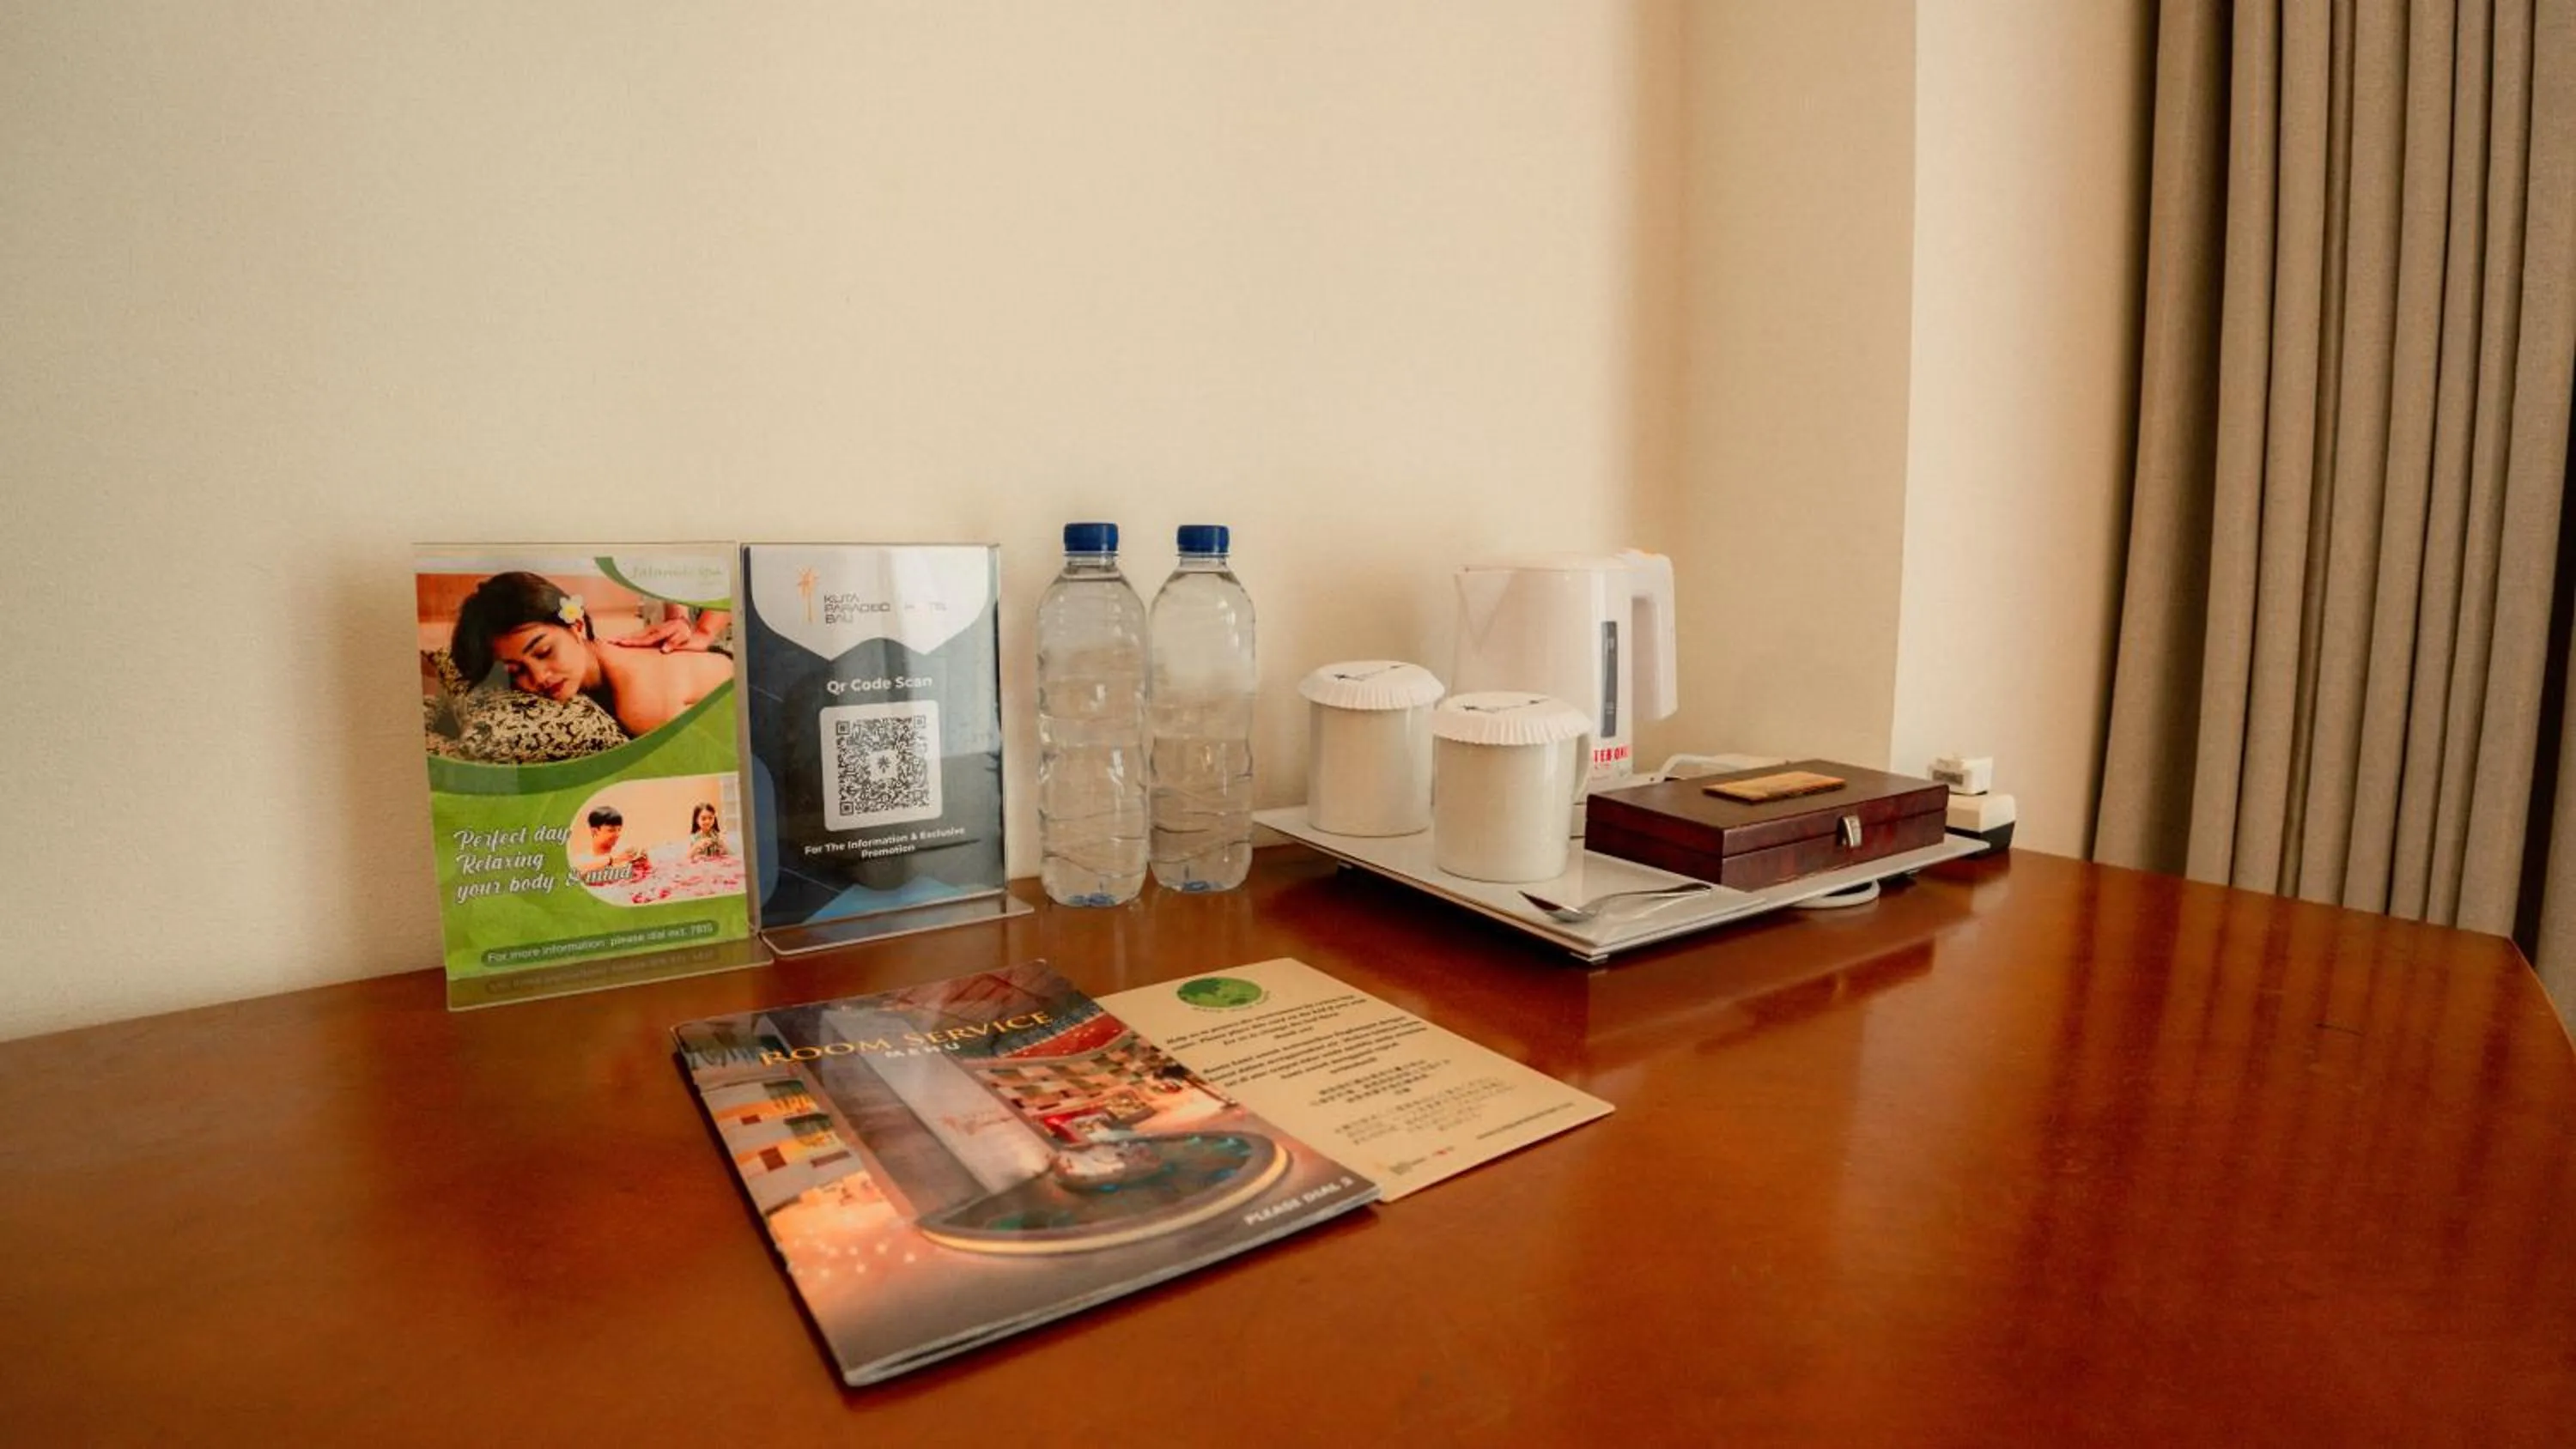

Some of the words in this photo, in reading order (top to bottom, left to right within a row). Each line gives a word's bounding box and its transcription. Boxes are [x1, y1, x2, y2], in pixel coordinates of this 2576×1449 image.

[824, 592, 860, 603] KUTA
[826, 680, 848, 695] Qr
[850, 676, 892, 692] Code
[895, 676, 933, 688] Scan
[453, 827, 527, 852] Perfect
[534, 825, 572, 846] day
[805, 845, 823, 856] For
[825, 842, 846, 852] The
[848, 833, 908, 851] Information
[910, 831, 919, 841] &
[920, 827, 967, 841] Exclusive
[860, 844, 916, 858] Promotion
[457, 852, 545, 876] Relaxing
[457, 881, 501, 904] your
[510, 873, 555, 894] body
[584, 863, 634, 883] mind
[488, 952, 507, 964] For
[509, 948, 541, 960] more
[611, 931, 645, 947] please
[646, 928, 666, 942] dial
[759, 1037, 892, 1067] ROOM
[903, 1009, 1054, 1046] SERVICE
[884, 1041, 963, 1059] MENU
[1243, 1197, 1303, 1226] PLEASE
[1302, 1182, 1342, 1204] DIAL
